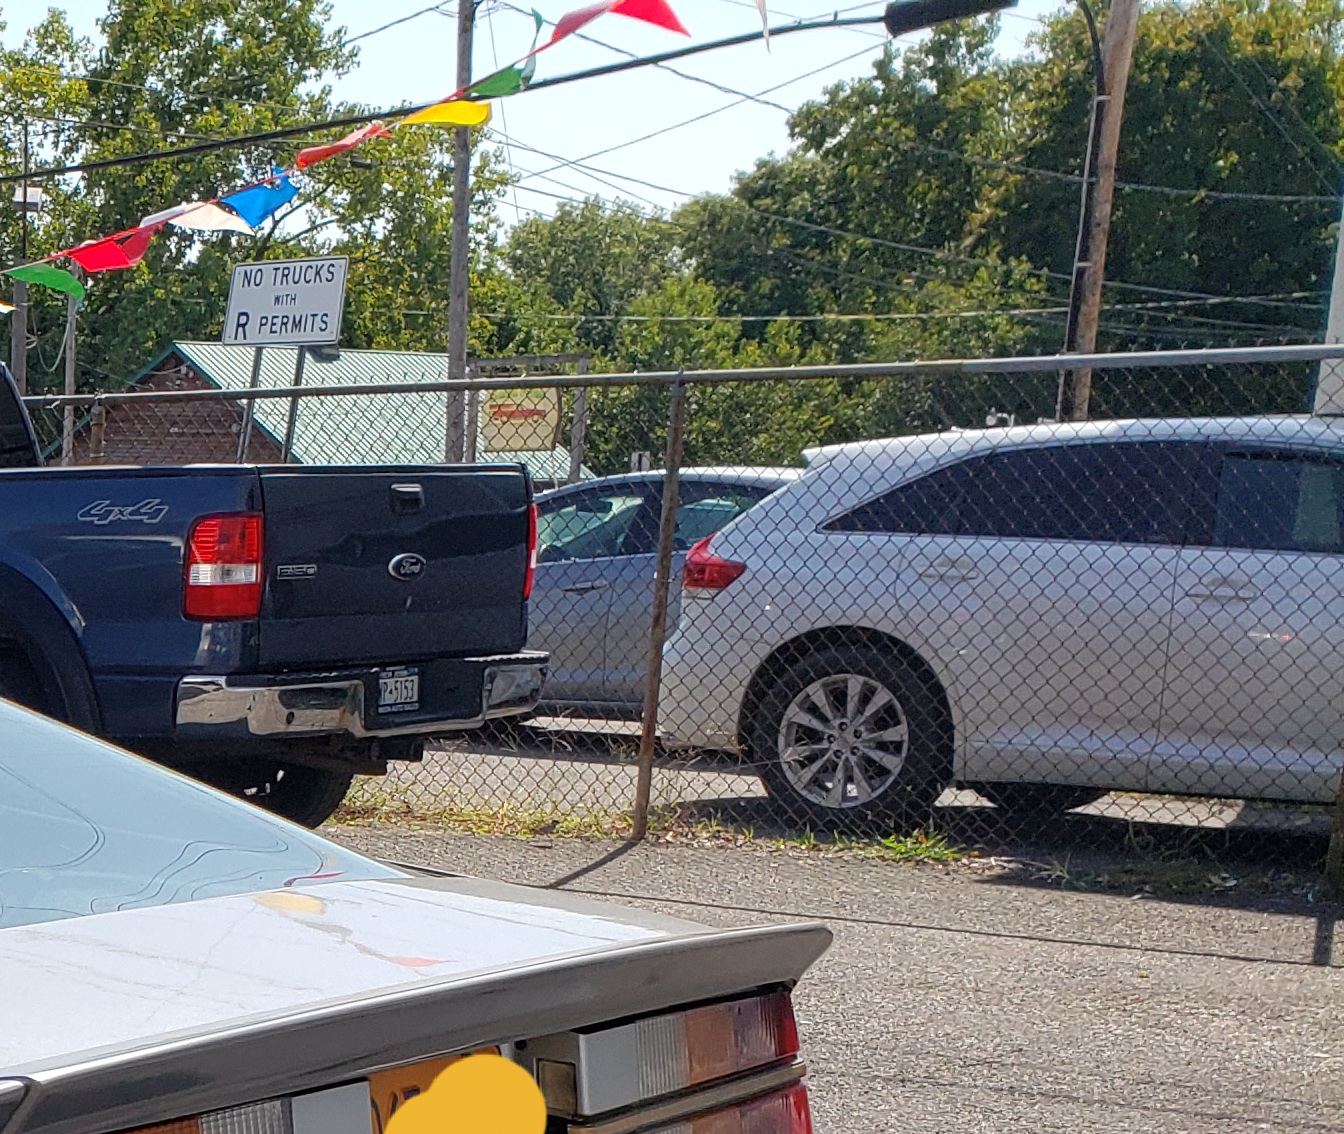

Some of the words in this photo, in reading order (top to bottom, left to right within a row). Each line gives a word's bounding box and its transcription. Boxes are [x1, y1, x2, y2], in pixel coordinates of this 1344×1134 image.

[241, 268, 264, 289] NO
[272, 263, 336, 287] TRUCKS
[273, 293, 298, 307] WITH
[233, 311, 251, 341] R
[257, 312, 330, 336] PERMITS
